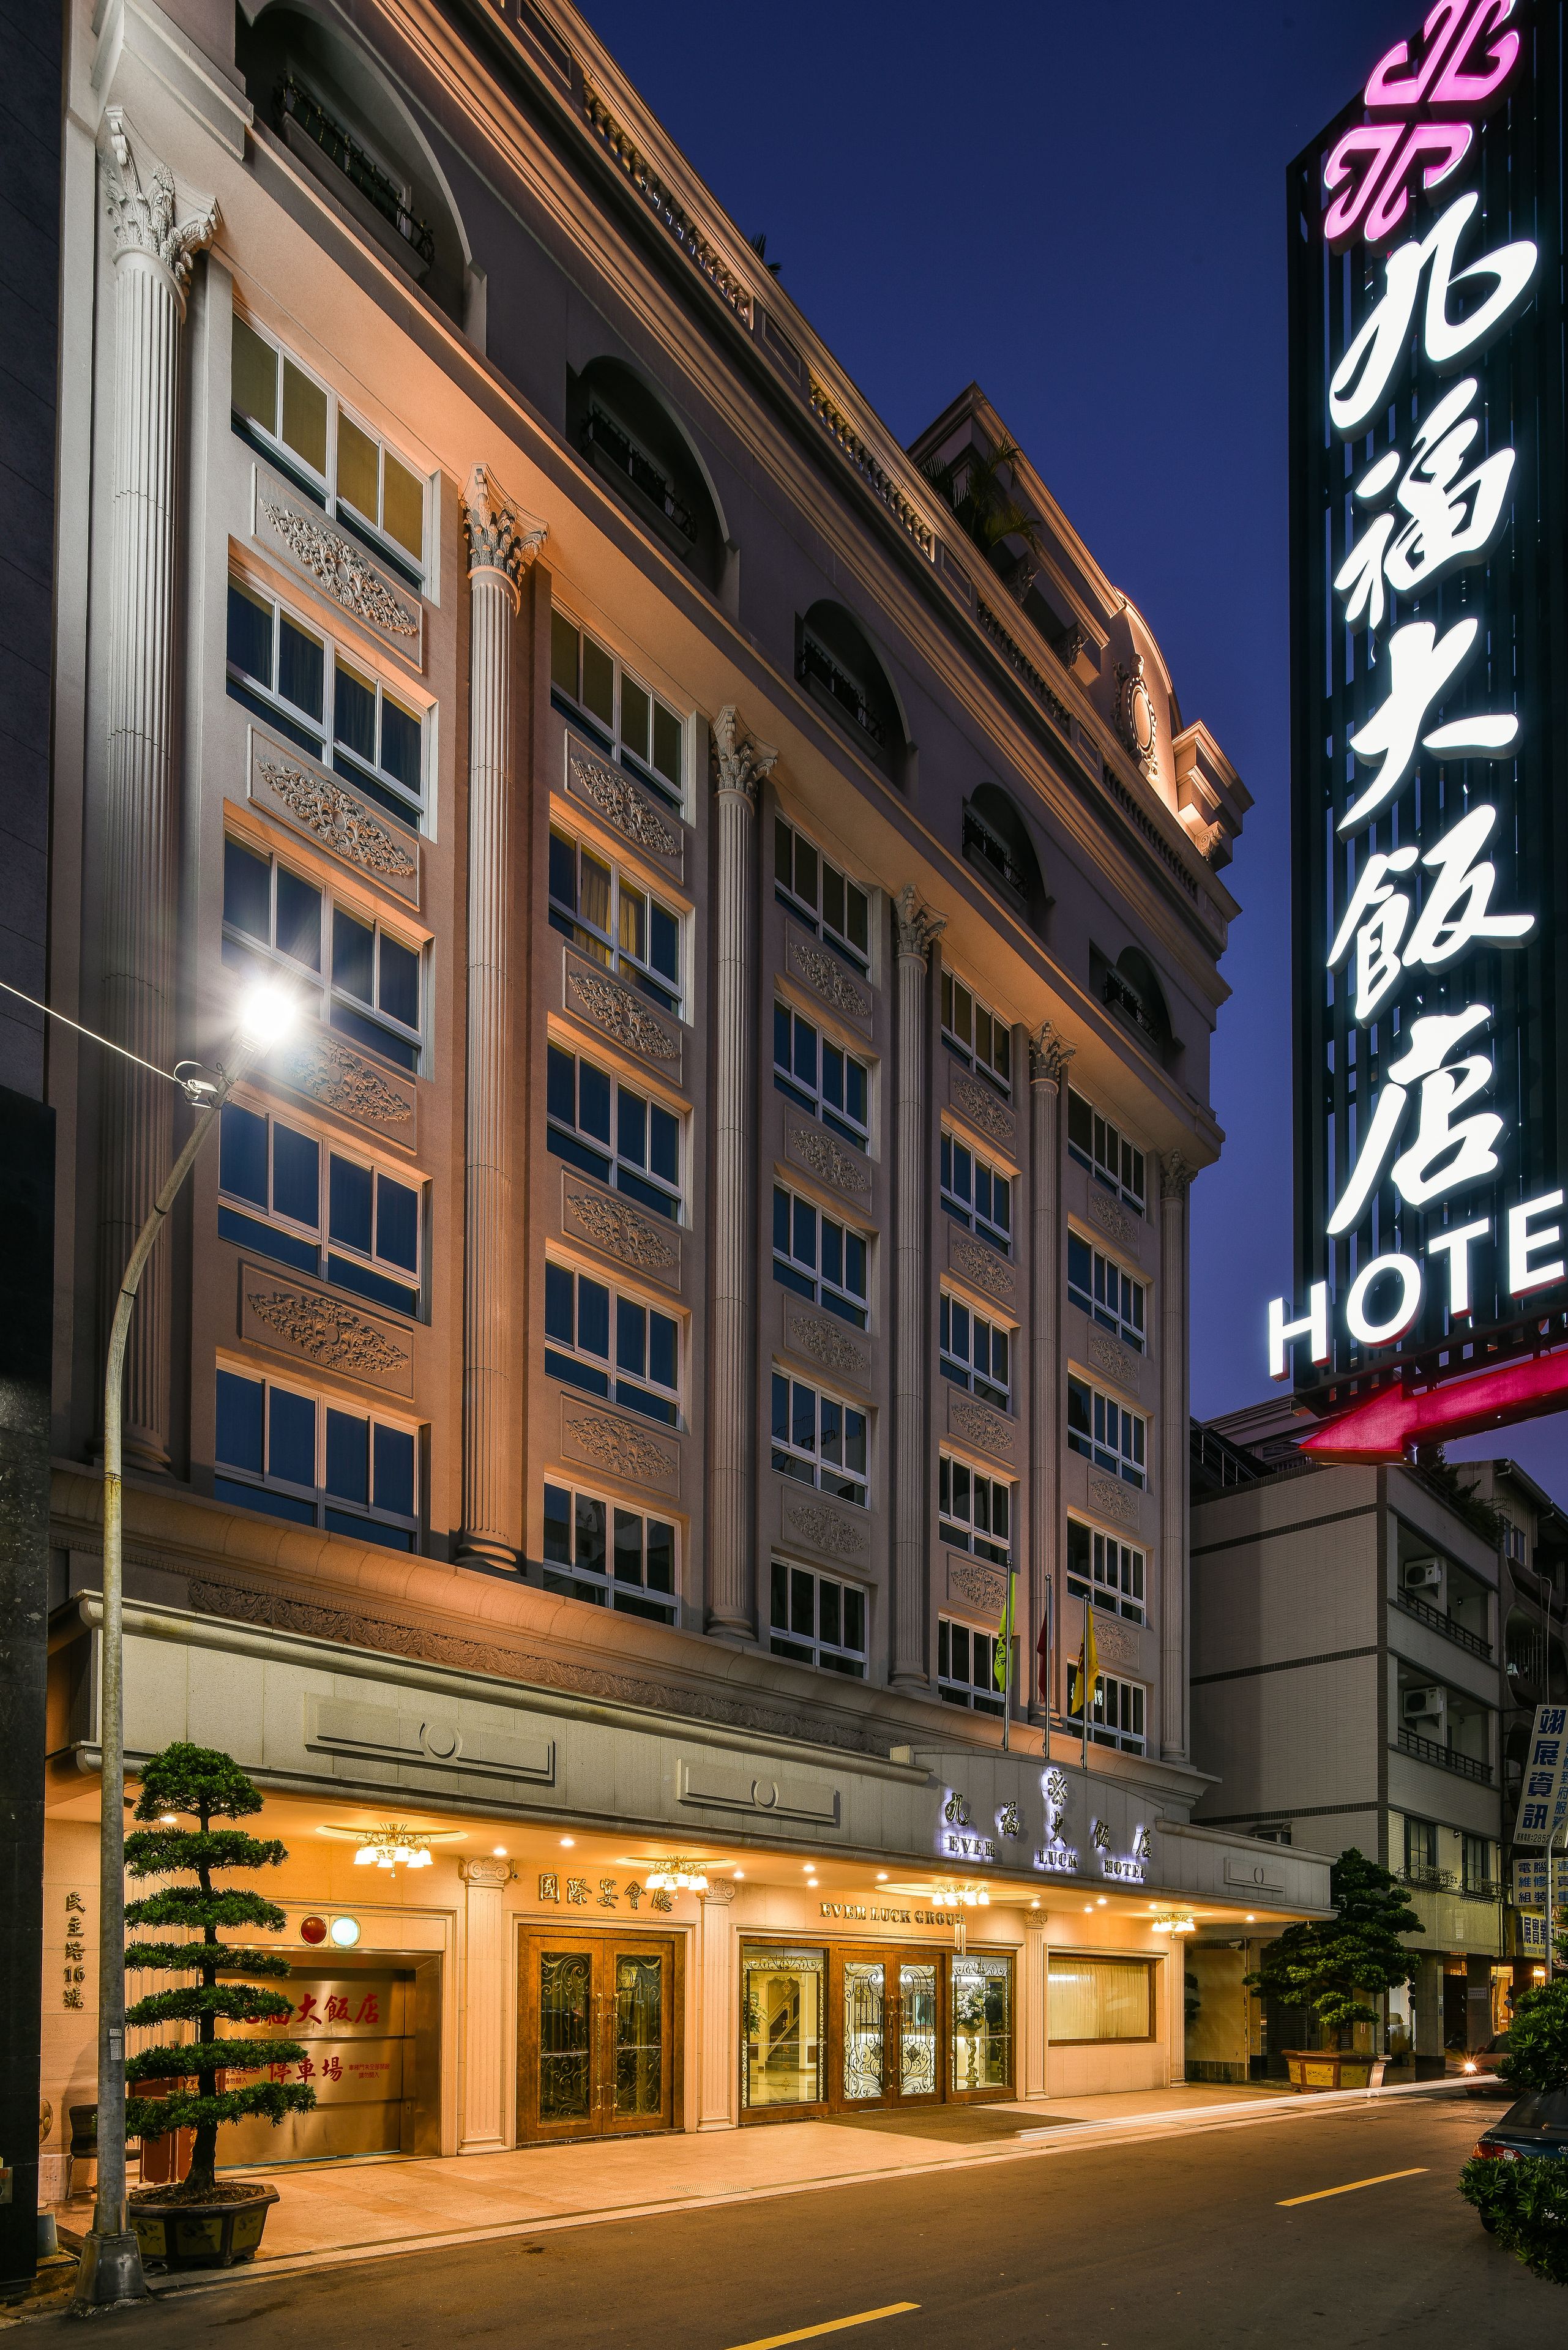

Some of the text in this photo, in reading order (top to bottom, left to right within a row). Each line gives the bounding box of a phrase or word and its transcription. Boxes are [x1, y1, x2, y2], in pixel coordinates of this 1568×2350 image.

[1326, 192, 1537, 1234] 九福大飯店
[1522, 1709, 1567, 1829] 翊展資訊
[945, 1792, 1152, 1859] 九福大飯店
[948, 1835, 1146, 1879] EVER LUCK HOTEL
[539, 1873, 673, 1912] 國際宴會廳
[819, 1902, 867, 1920] EVER
[870, 1907, 911, 1923] LUCK
[62, 1891, 86, 2009] 民主路16號
[267, 2056, 343, 2085] 停車場
